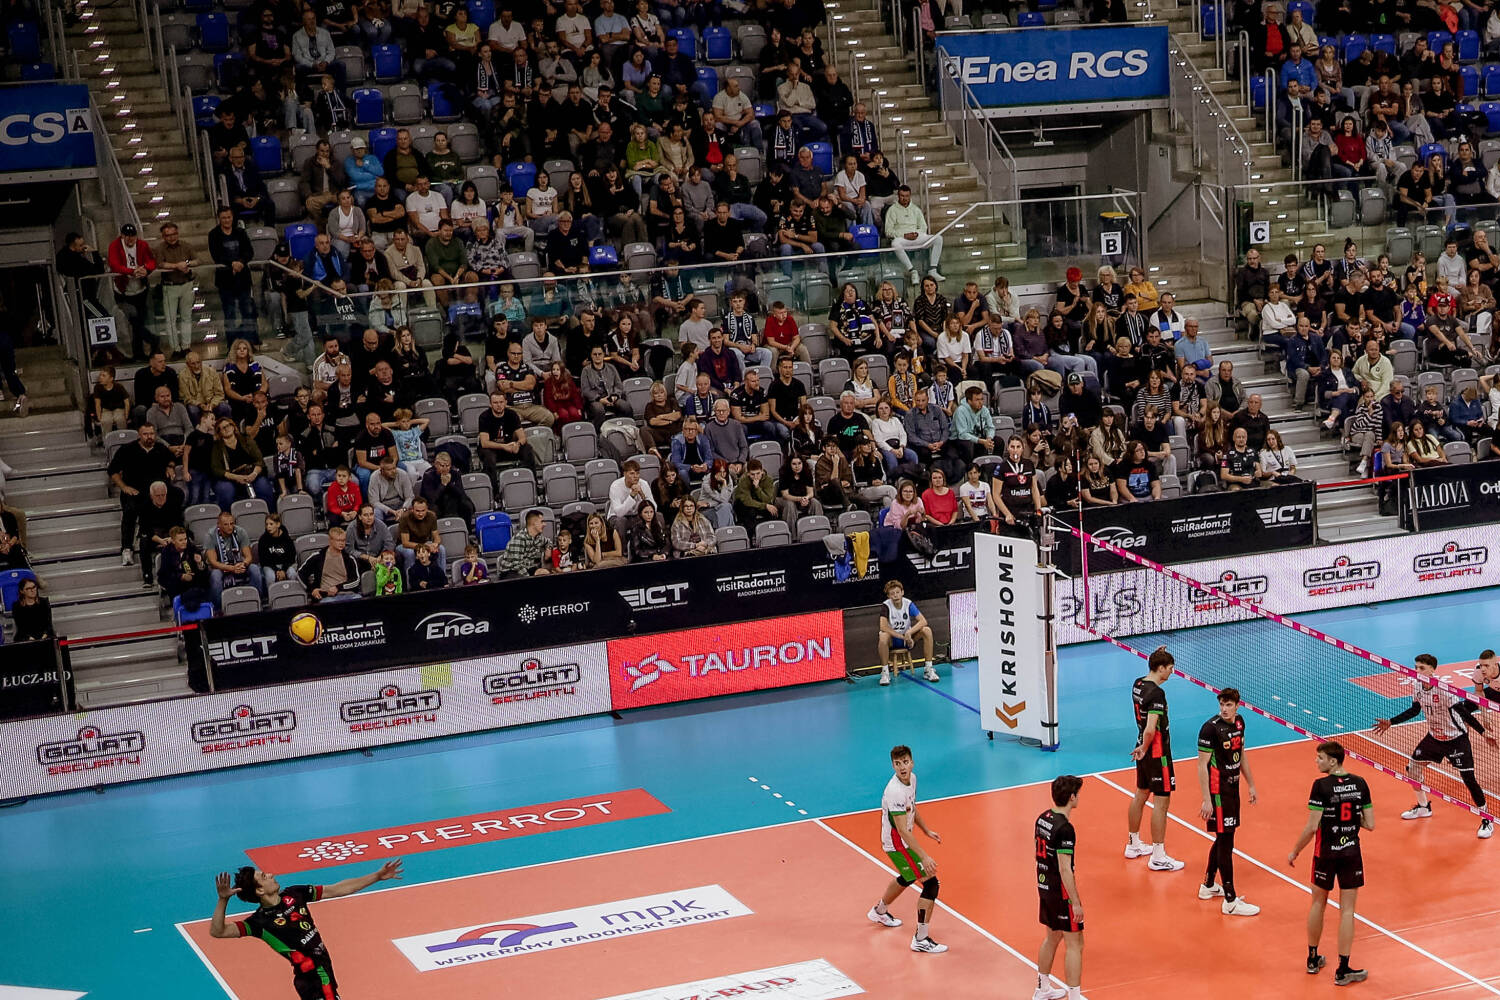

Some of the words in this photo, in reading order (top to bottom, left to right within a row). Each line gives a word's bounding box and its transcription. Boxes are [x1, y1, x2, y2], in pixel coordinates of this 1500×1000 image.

[962, 56, 1058, 85] Enea
[1068, 49, 1149, 79] RCS
[72, 116, 89, 132] A
[1254, 228, 1266, 241] C
[1105, 238, 1118, 253] B
[95, 325, 112, 342] B
[1170, 517, 1232, 535] visitRadom.pl
[1417, 552, 1483, 568] GOLIAT
[1307, 565, 1376, 583] GOLIAT
[1418, 567, 1482, 582] SECURITY
[716, 575, 786, 593] visitRadom.pl
[1308, 582, 1375, 597] SECURITY
[540, 601, 590, 617] PIERROT
[893, 620, 906, 631] 22
[999, 543, 1017, 696] KRISHOME
[315, 628, 385, 646] sitRadom.pl
[426, 619, 490, 640] Enea
[681, 637, 831, 677] TAURON
[490, 668, 573, 690] GOLIAT
[347, 694, 434, 717] GOLIAT
[491, 687, 575, 705] SECURITY
[200, 714, 289, 737] GOLIAT
[350, 713, 437, 733] SECURITY
[45, 735, 138, 759] GOLIAT
[201, 734, 291, 754] SECURITY
[47, 756, 140, 776] SECURITY
[1340, 801, 1352, 821] 6
[377, 799, 614, 850] PIERROT
[1223, 817, 1234, 827] 32
[599, 898, 706, 927] mpk
[434, 939, 555, 967] WSPIERAMY
[560, 921, 666, 945] RADOMSKI
[668, 908, 731, 929] SPORT
